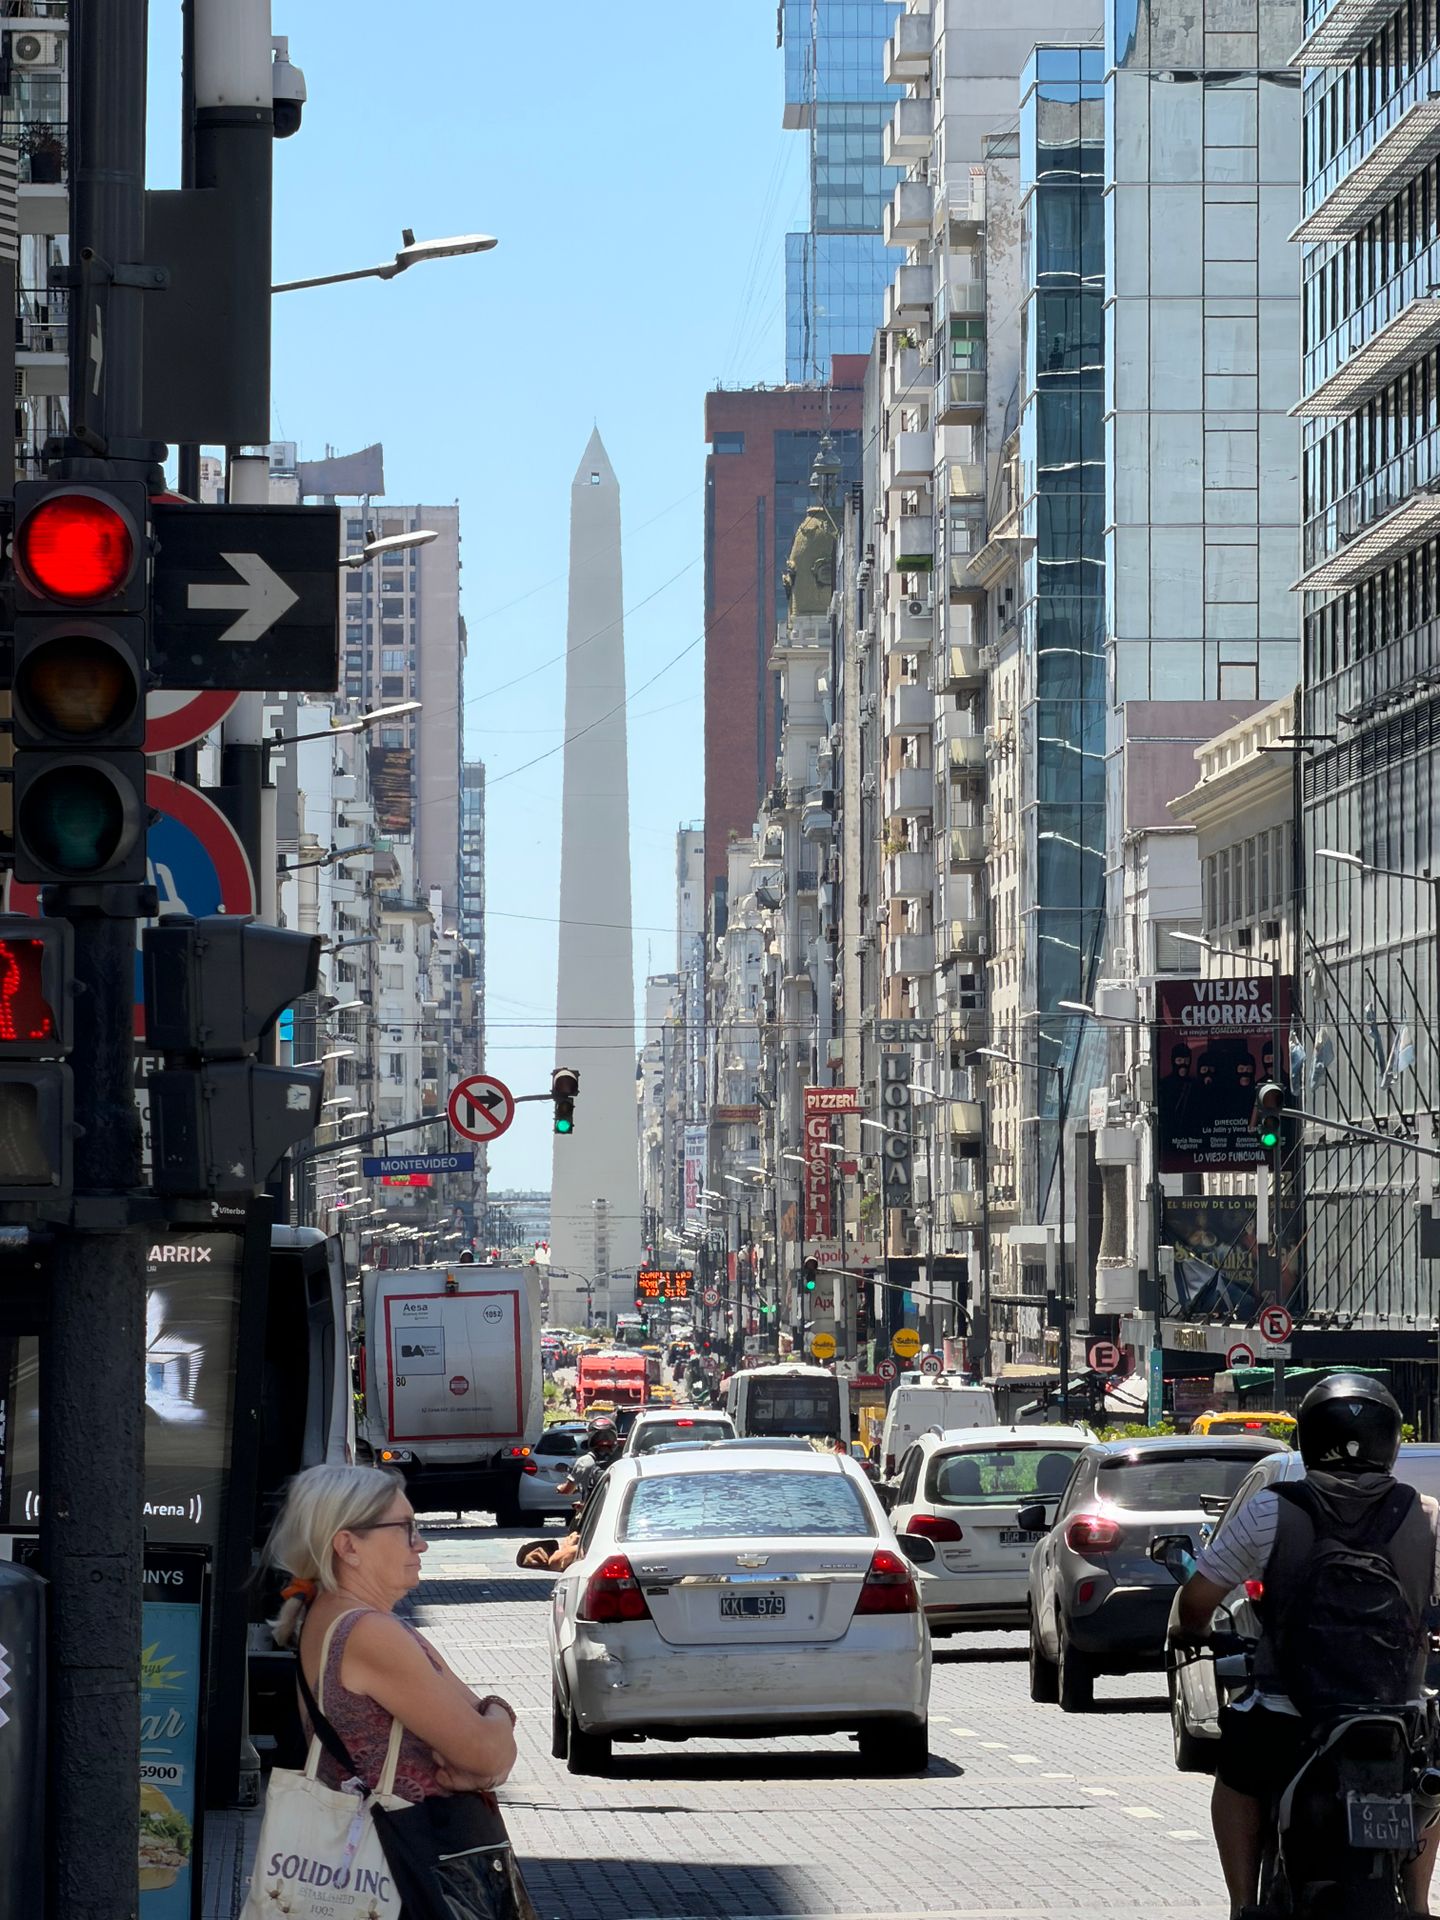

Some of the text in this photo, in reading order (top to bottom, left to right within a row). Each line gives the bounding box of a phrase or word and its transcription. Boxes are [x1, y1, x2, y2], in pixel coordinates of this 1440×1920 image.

[1193, 980, 1259, 1001] VIEJAS
[1181, 1003, 1272, 1025] CHORRAS
[880, 1023, 935, 1040] CIN
[807, 1094, 859, 1108] PIZZERI
[884, 1060, 909, 1184] LORCA
[380, 1157, 458, 1171] MONTEVIDEO
[1193, 1150, 1266, 1163] LO VIEJO FUNCIONA
[902, 1192, 911, 1204] 2
[1167, 1201, 1178, 1209] EL
[1182, 1201, 1208, 1209] SHOW
[1212, 1201, 1224, 1209] DE
[1228, 1201, 1240, 1209] LO
[219, 1207, 246, 1215] Viterbo
[147, 1245, 212, 1263] ARRIX
[814, 1249, 850, 1265] Apolo
[403, 1303, 429, 1312] Aesa
[1270, 1314, 1284, 1334] E
[401, 1345, 425, 1358] BA
[1096, 1346, 1113, 1367] E
[925, 1361, 938, 1373] 30
[395, 1377, 406, 1387] 80
[143, 1502, 185, 1516] Arena
[143, 1570, 184, 1585] NYS
[722, 1597, 784, 1615] KKL 979
[140, 1707, 186, 1741] ar
[267, 1853, 390, 1903] SOLIDO INC
